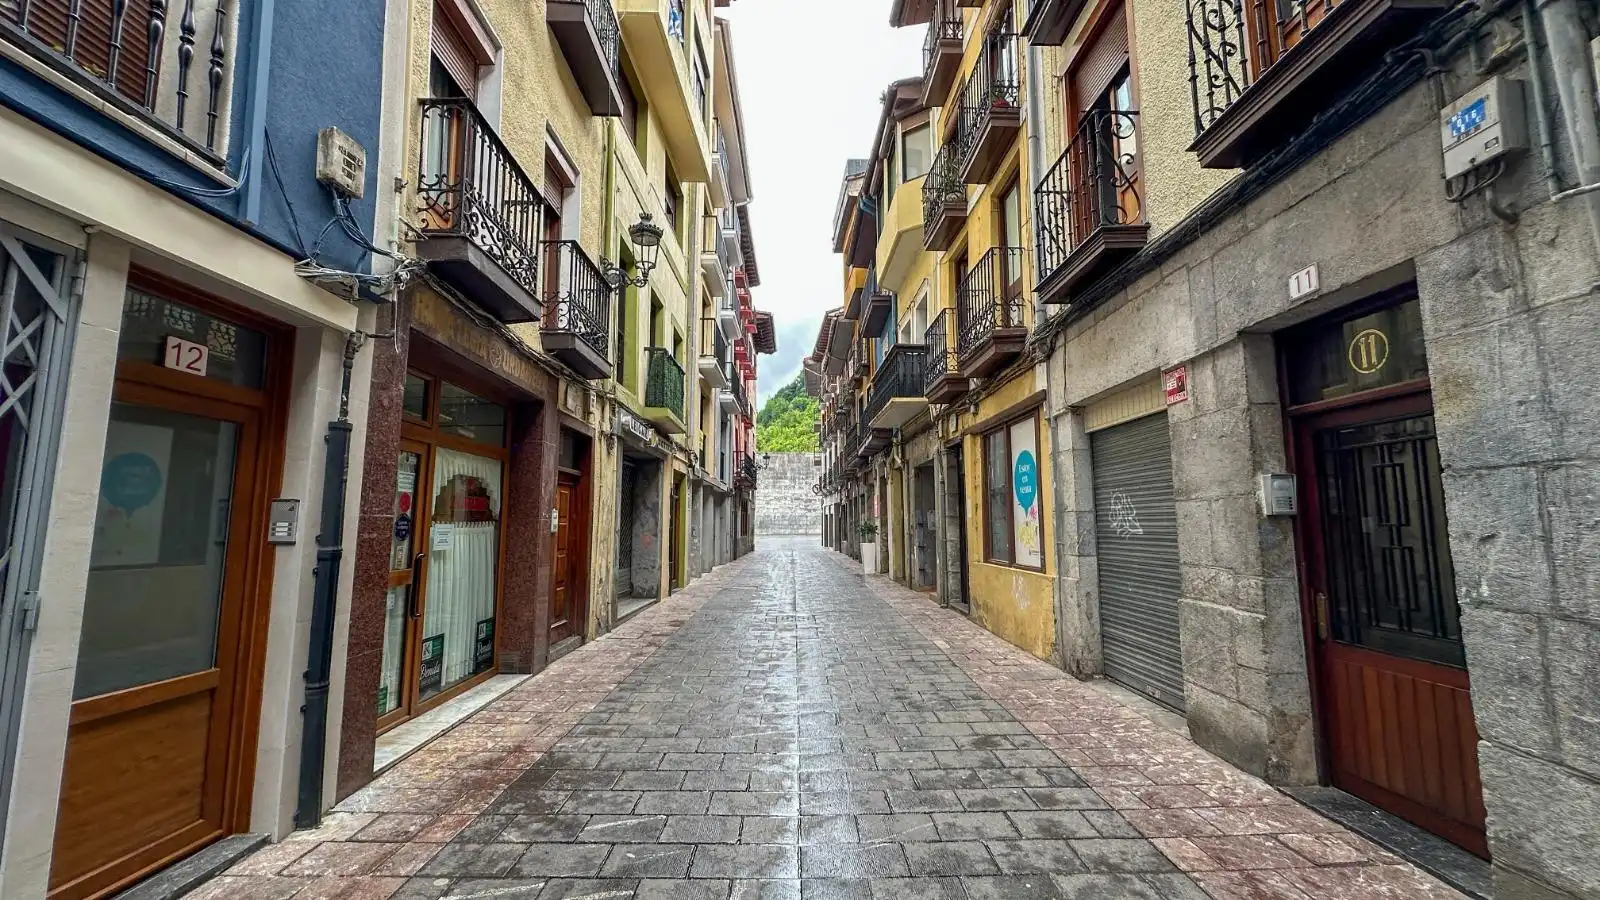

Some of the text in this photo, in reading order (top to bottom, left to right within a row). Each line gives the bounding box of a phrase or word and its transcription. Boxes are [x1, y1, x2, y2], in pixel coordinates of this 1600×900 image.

[1294, 269, 1312, 295] 11
[171, 342, 204, 373] 12
[1358, 334, 1378, 370] 11
